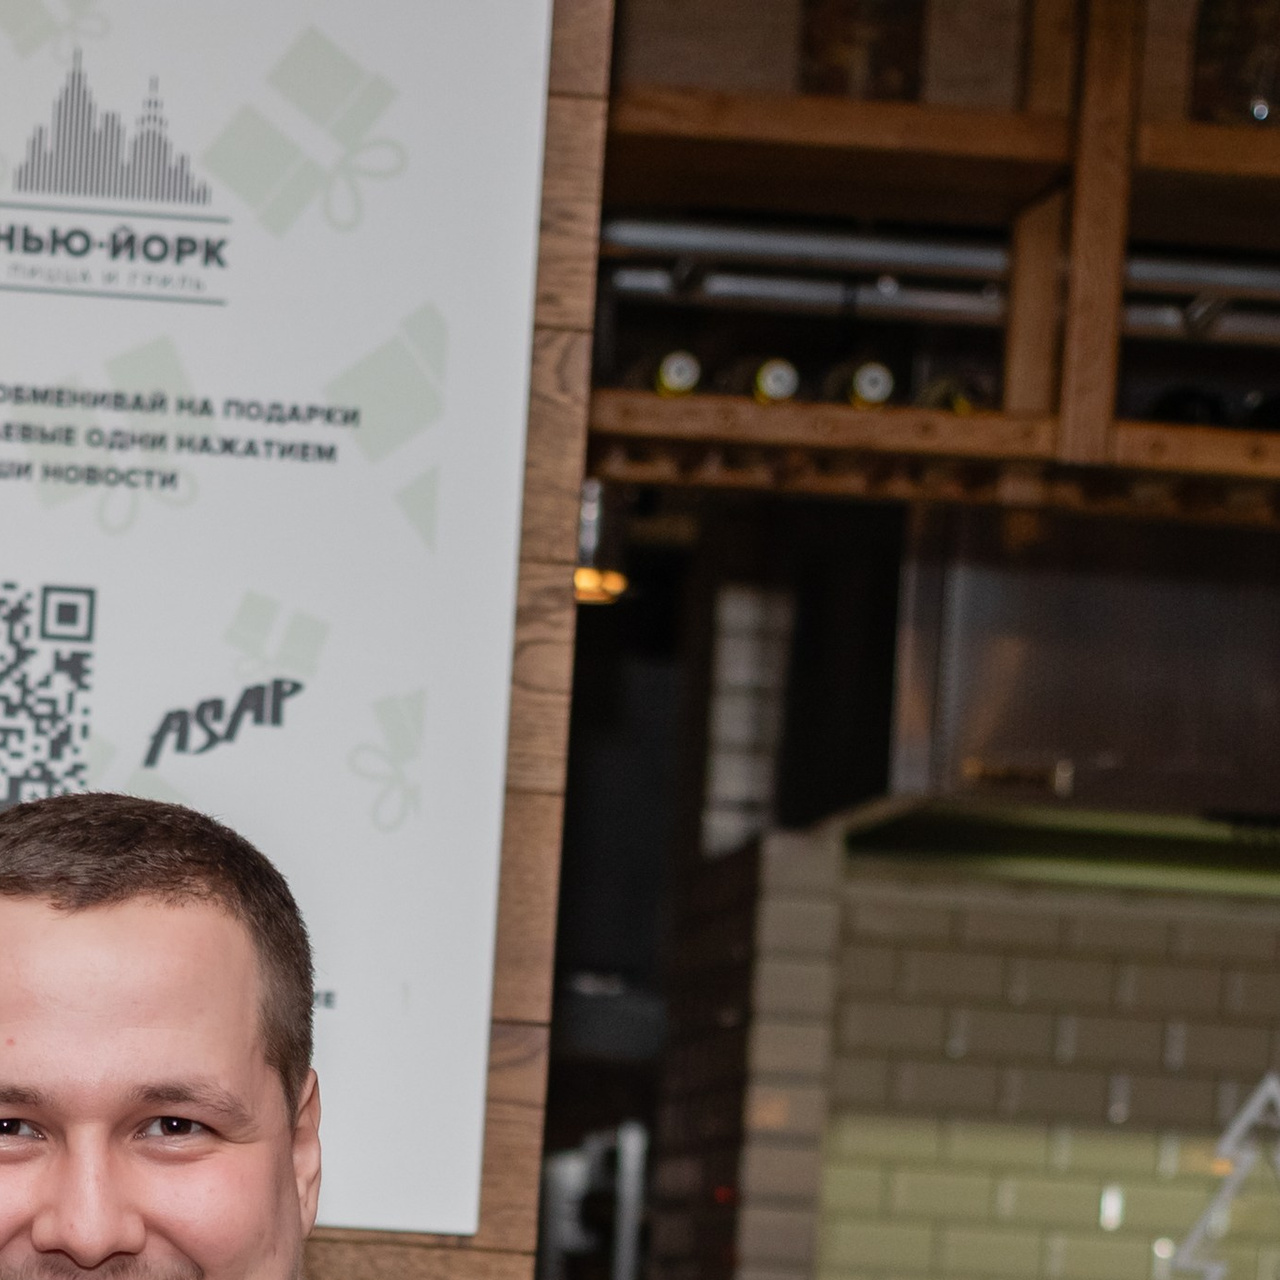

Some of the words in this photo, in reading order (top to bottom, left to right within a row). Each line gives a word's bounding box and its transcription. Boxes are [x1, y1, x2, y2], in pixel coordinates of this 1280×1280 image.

[176, 398, 213, 417] НА
[224, 399, 360, 426] ПОДАРКИ
[176, 434, 337, 462] НАЖАТИЕМ
[42, 463, 178, 489] НОВОСТИ
[143, 678, 303, 768] ASAP
